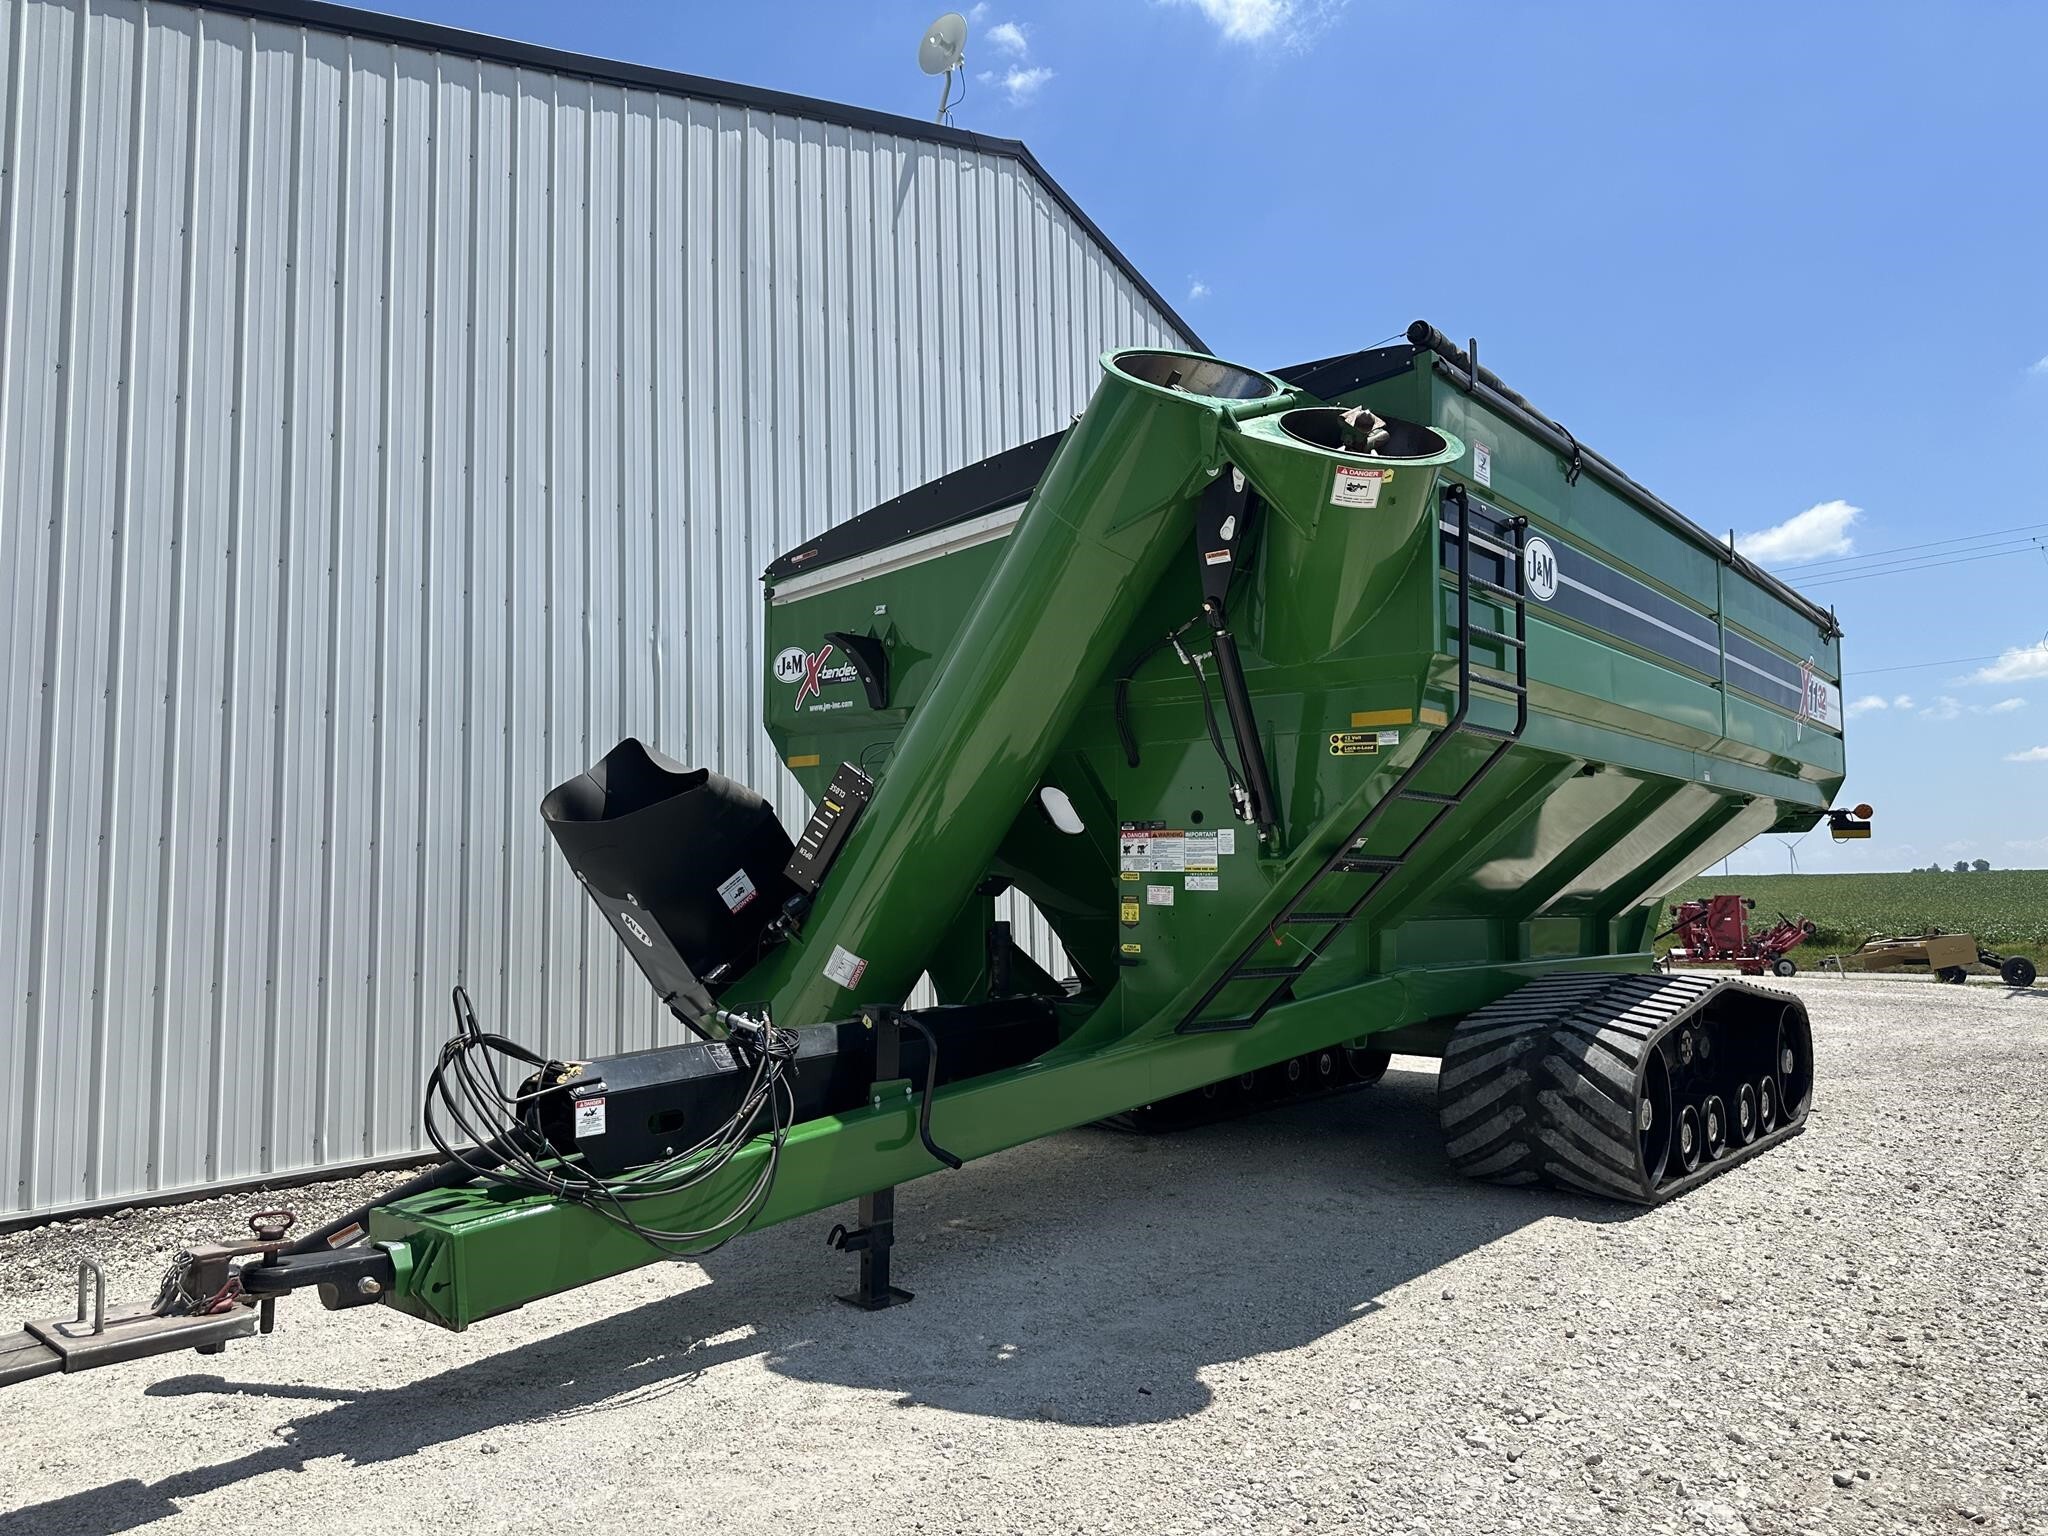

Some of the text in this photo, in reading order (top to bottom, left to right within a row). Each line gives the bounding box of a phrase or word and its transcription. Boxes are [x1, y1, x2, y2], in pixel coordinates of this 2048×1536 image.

[1349, 469, 1379, 477] DANGER
[1527, 549, 1553, 590] J&M
[777, 654, 803, 677] J&M
[809, 700, 853, 712] www.jm-inc.com
[829, 783, 846, 799] CLOSE
[799, 847, 813, 861] OPEN
